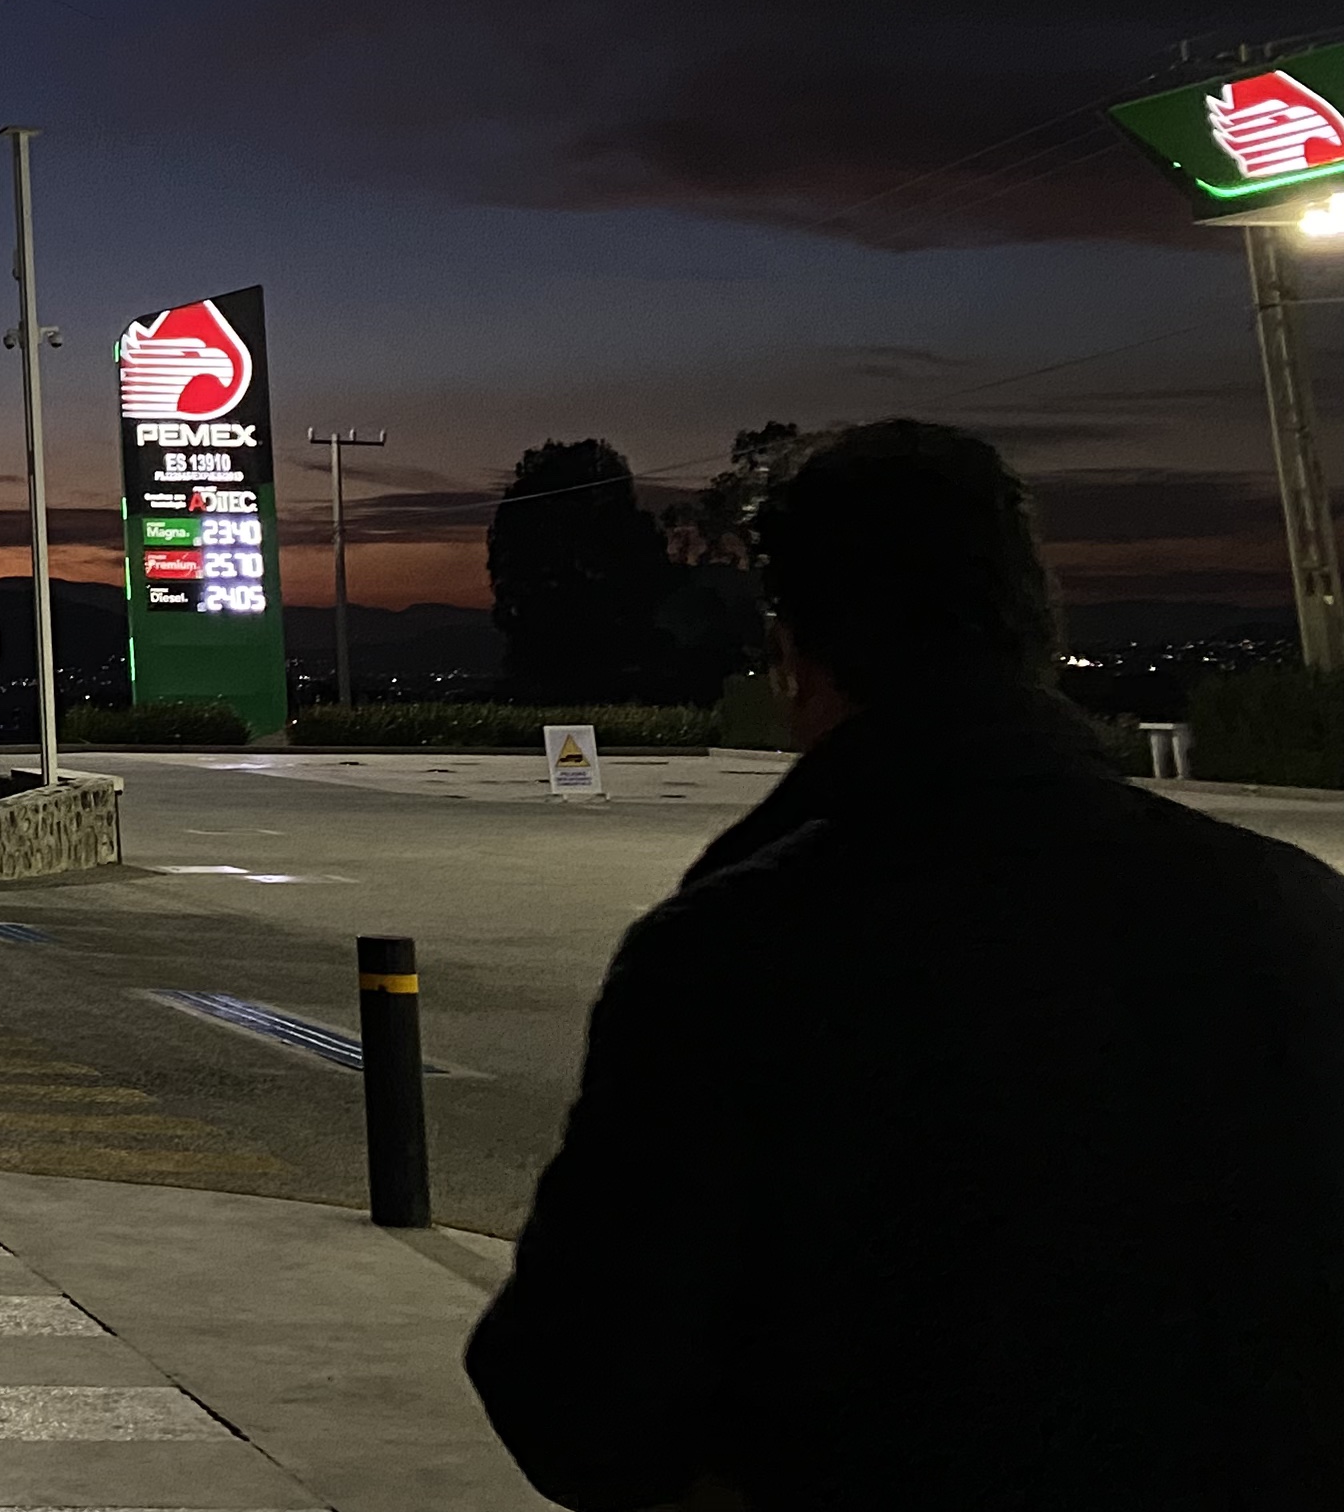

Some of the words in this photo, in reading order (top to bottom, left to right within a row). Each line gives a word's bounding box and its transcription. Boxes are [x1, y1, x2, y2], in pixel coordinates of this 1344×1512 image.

[136, 423, 257, 447] PEMEX
[164, 453, 187, 472] ES
[189, 453, 231, 472] 13910
